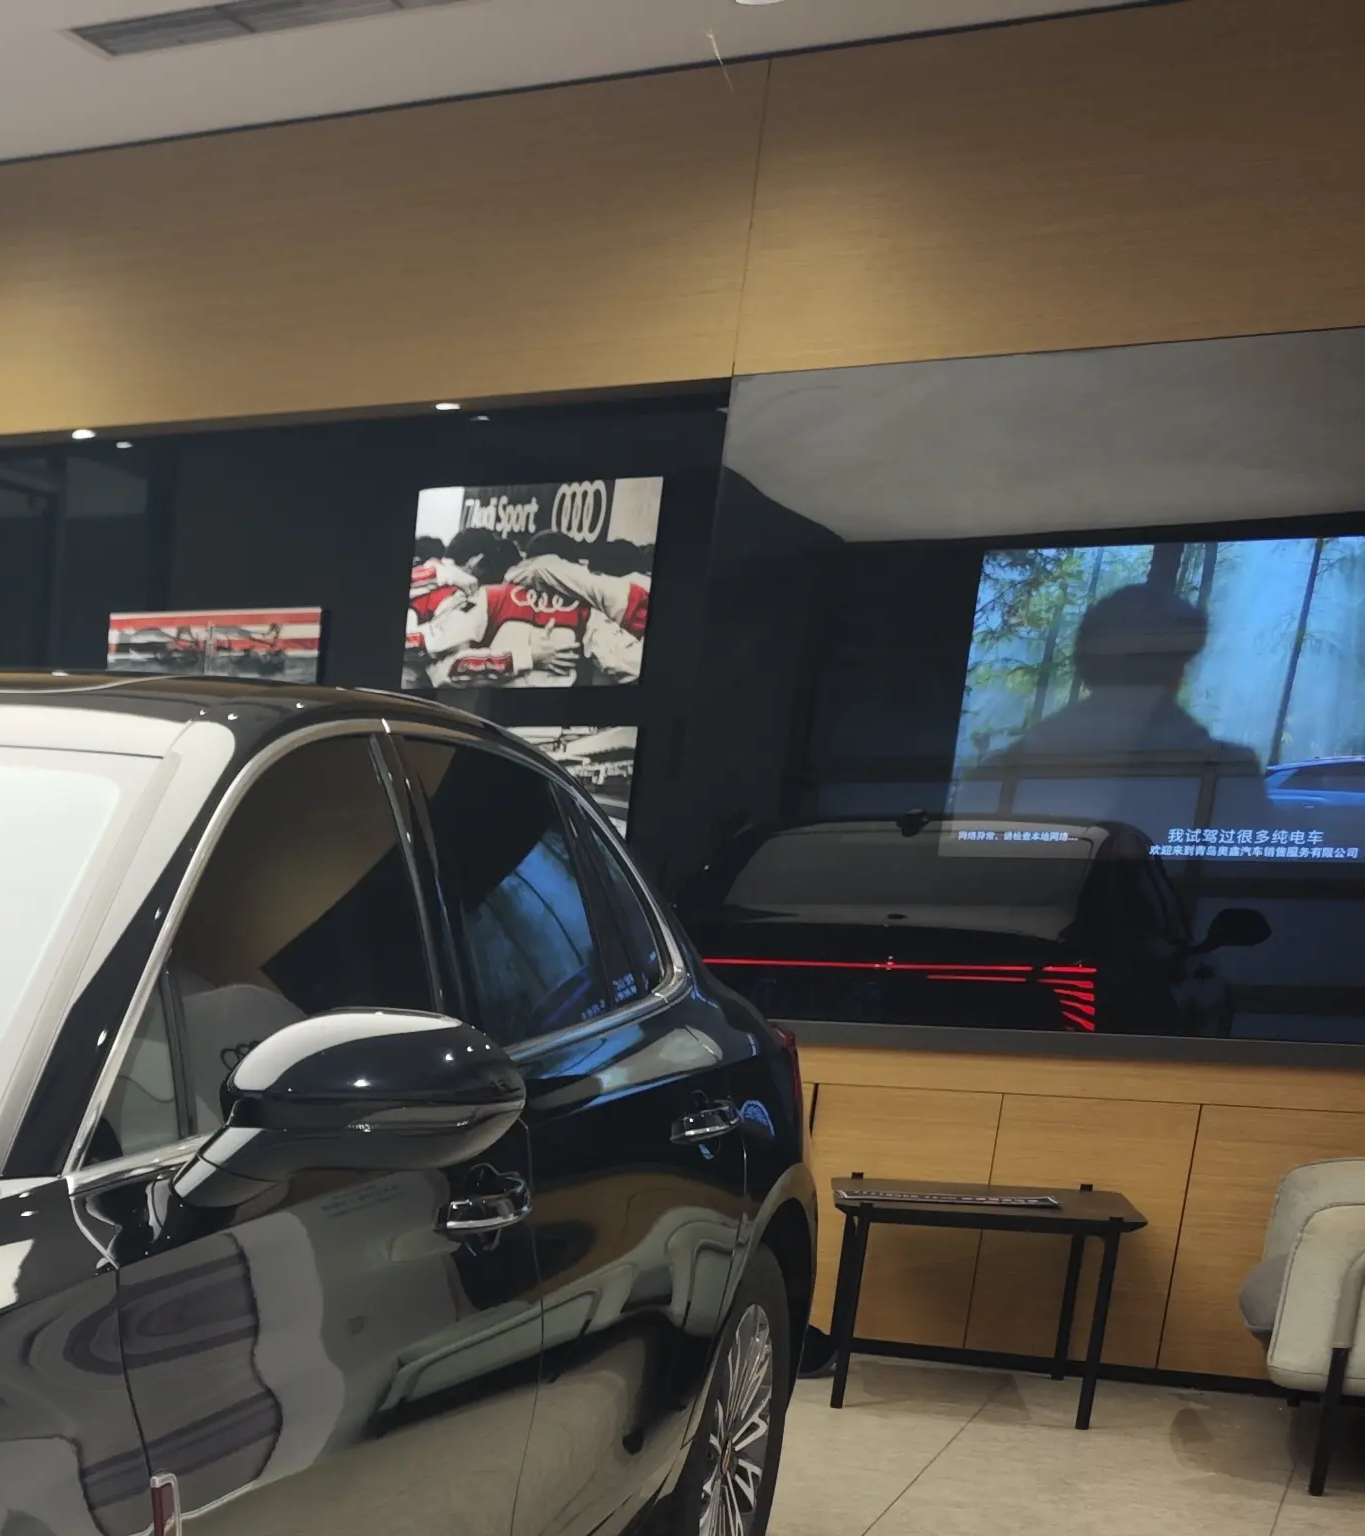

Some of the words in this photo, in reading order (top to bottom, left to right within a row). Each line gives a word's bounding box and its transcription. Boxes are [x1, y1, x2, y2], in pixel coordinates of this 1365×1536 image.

[496, 495, 538, 539] Sport
[1167, 828, 1324, 846] 我试驾过很多纯电车
[1148, 844, 1360, 859] 欢迎来到青岛奥鑫汽车销售服务有限公司
